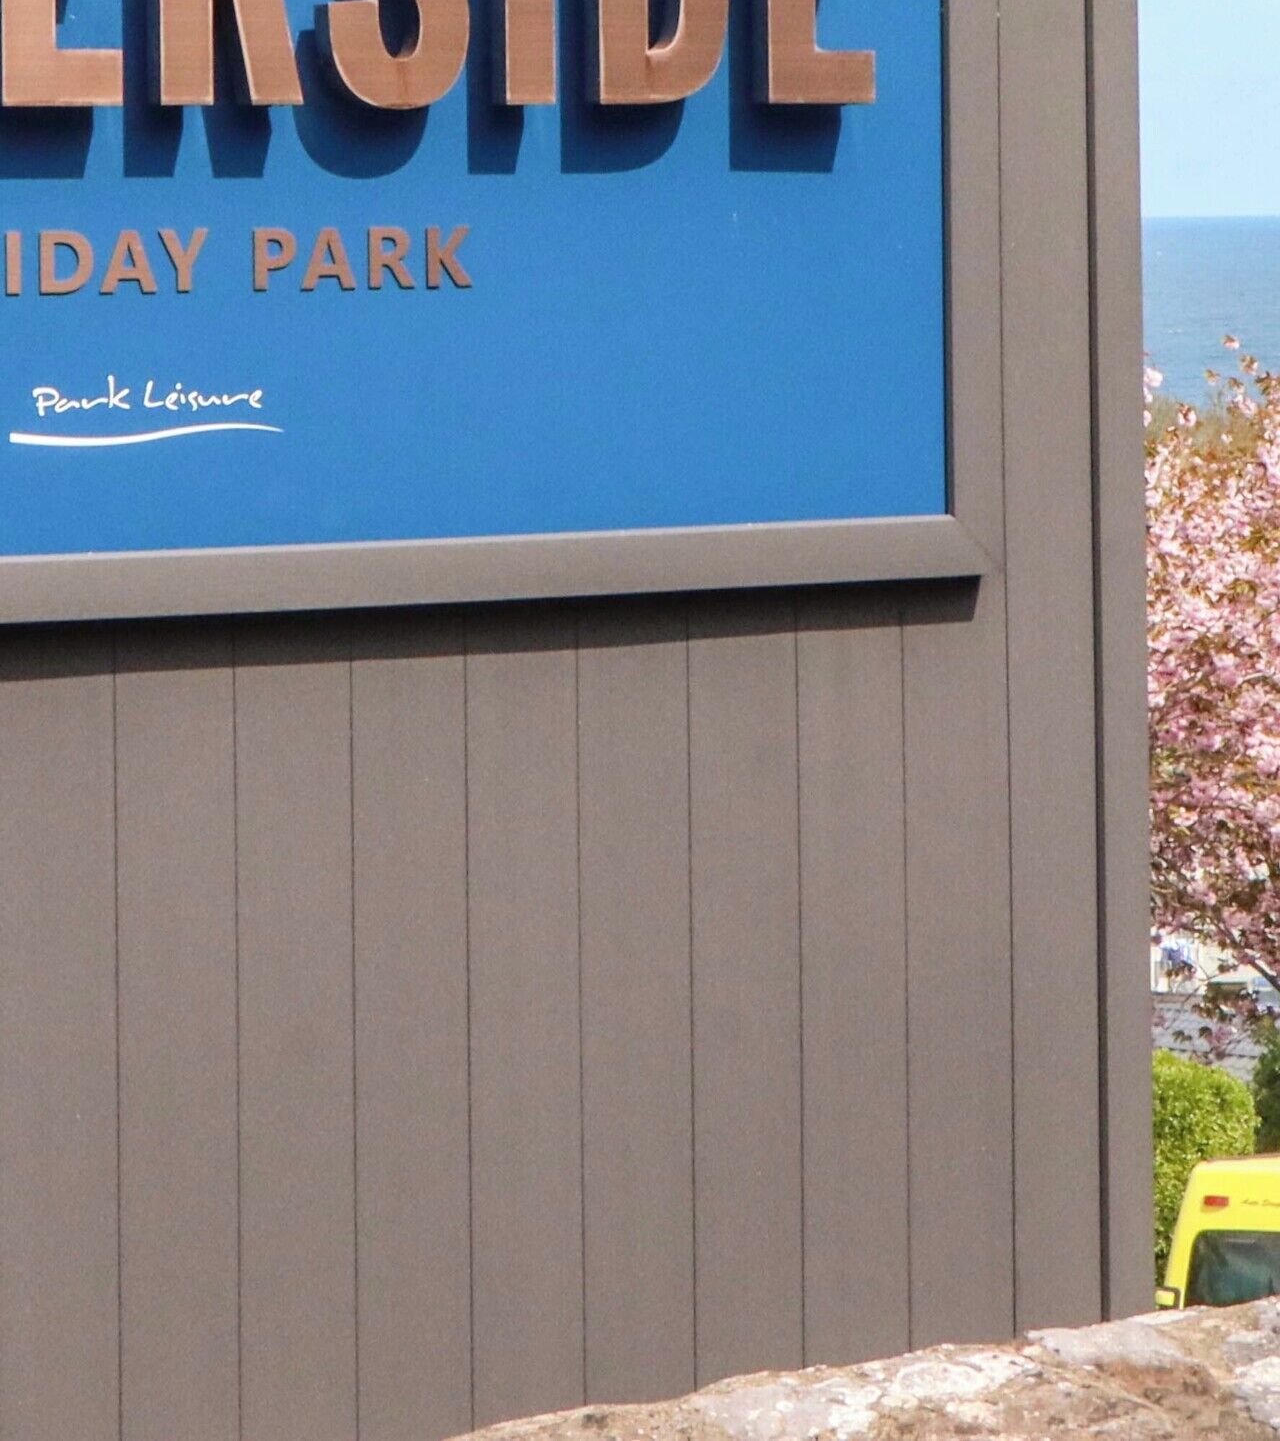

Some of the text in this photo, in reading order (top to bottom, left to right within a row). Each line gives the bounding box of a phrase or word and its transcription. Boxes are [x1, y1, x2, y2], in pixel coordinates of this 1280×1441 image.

[253, 225, 473, 291] PARK
[32, 374, 263, 416] Park Leisure
